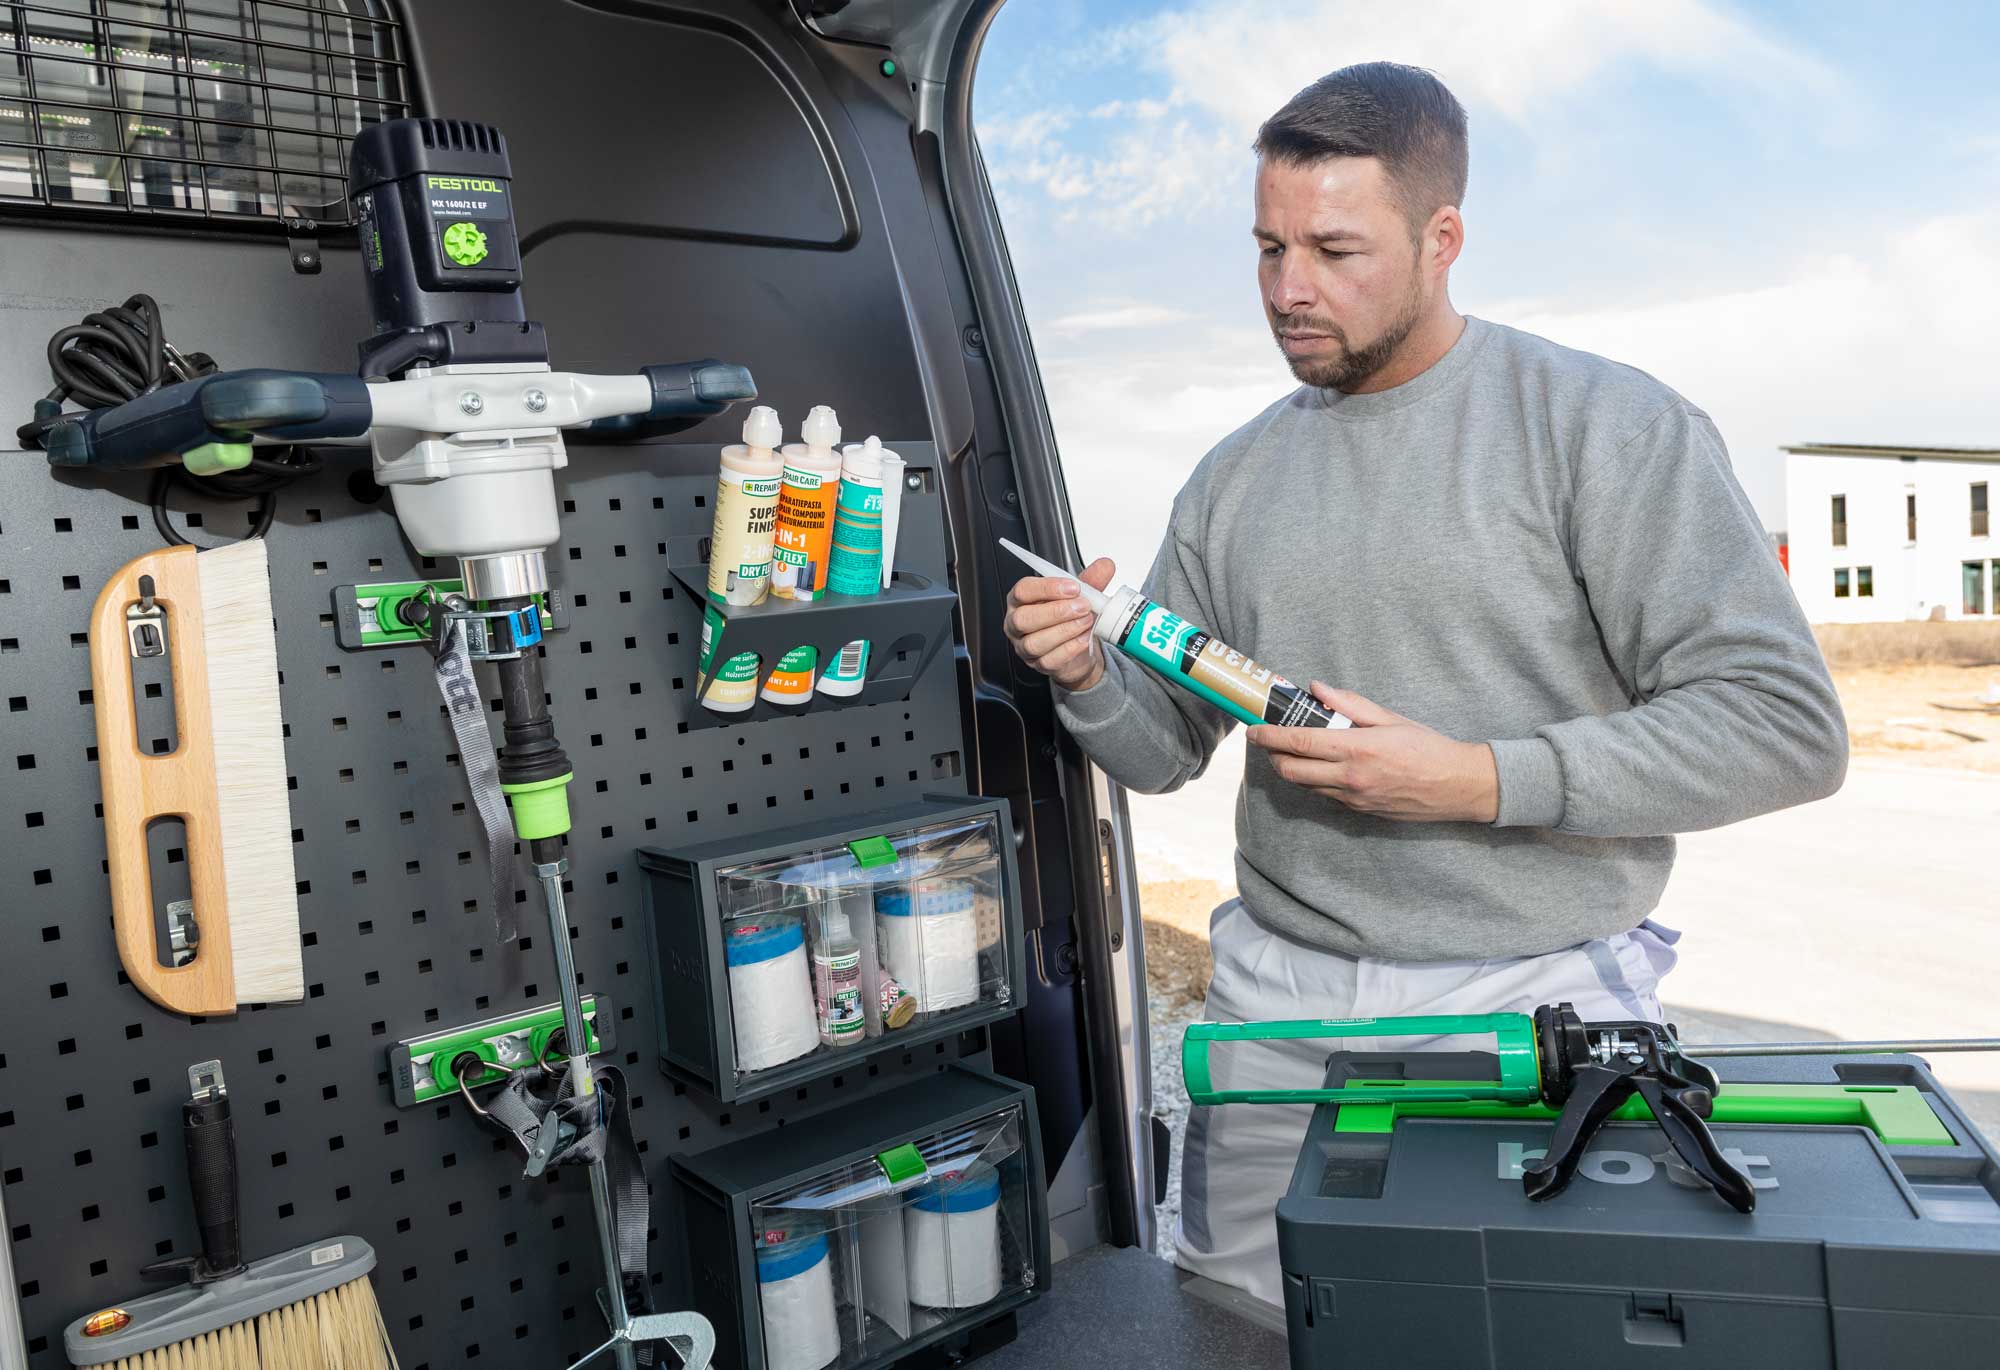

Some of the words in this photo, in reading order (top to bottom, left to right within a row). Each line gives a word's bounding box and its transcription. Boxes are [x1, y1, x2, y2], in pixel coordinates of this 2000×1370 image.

[428, 177, 503, 193] FESTOOL
[431, 199, 444, 208] MX
[445, 200, 471, 209] 1600/2
[478, 201, 488, 209] EF
[754, 482, 777, 493] REPAIR
[799, 475, 819, 487] CARE
[780, 493, 822, 510] EPARATIEPASTA
[863, 498, 882, 511] F13
[749, 505, 779, 520] SUPE
[792, 508, 826, 519] COMPOUND
[747, 520, 776, 534] FINIS
[776, 528, 806, 548] -IN-1
[783, 551, 804, 565] FLEX
[741, 565, 759, 577] DRY
[1188, 635, 1207, 657] ACRYL
